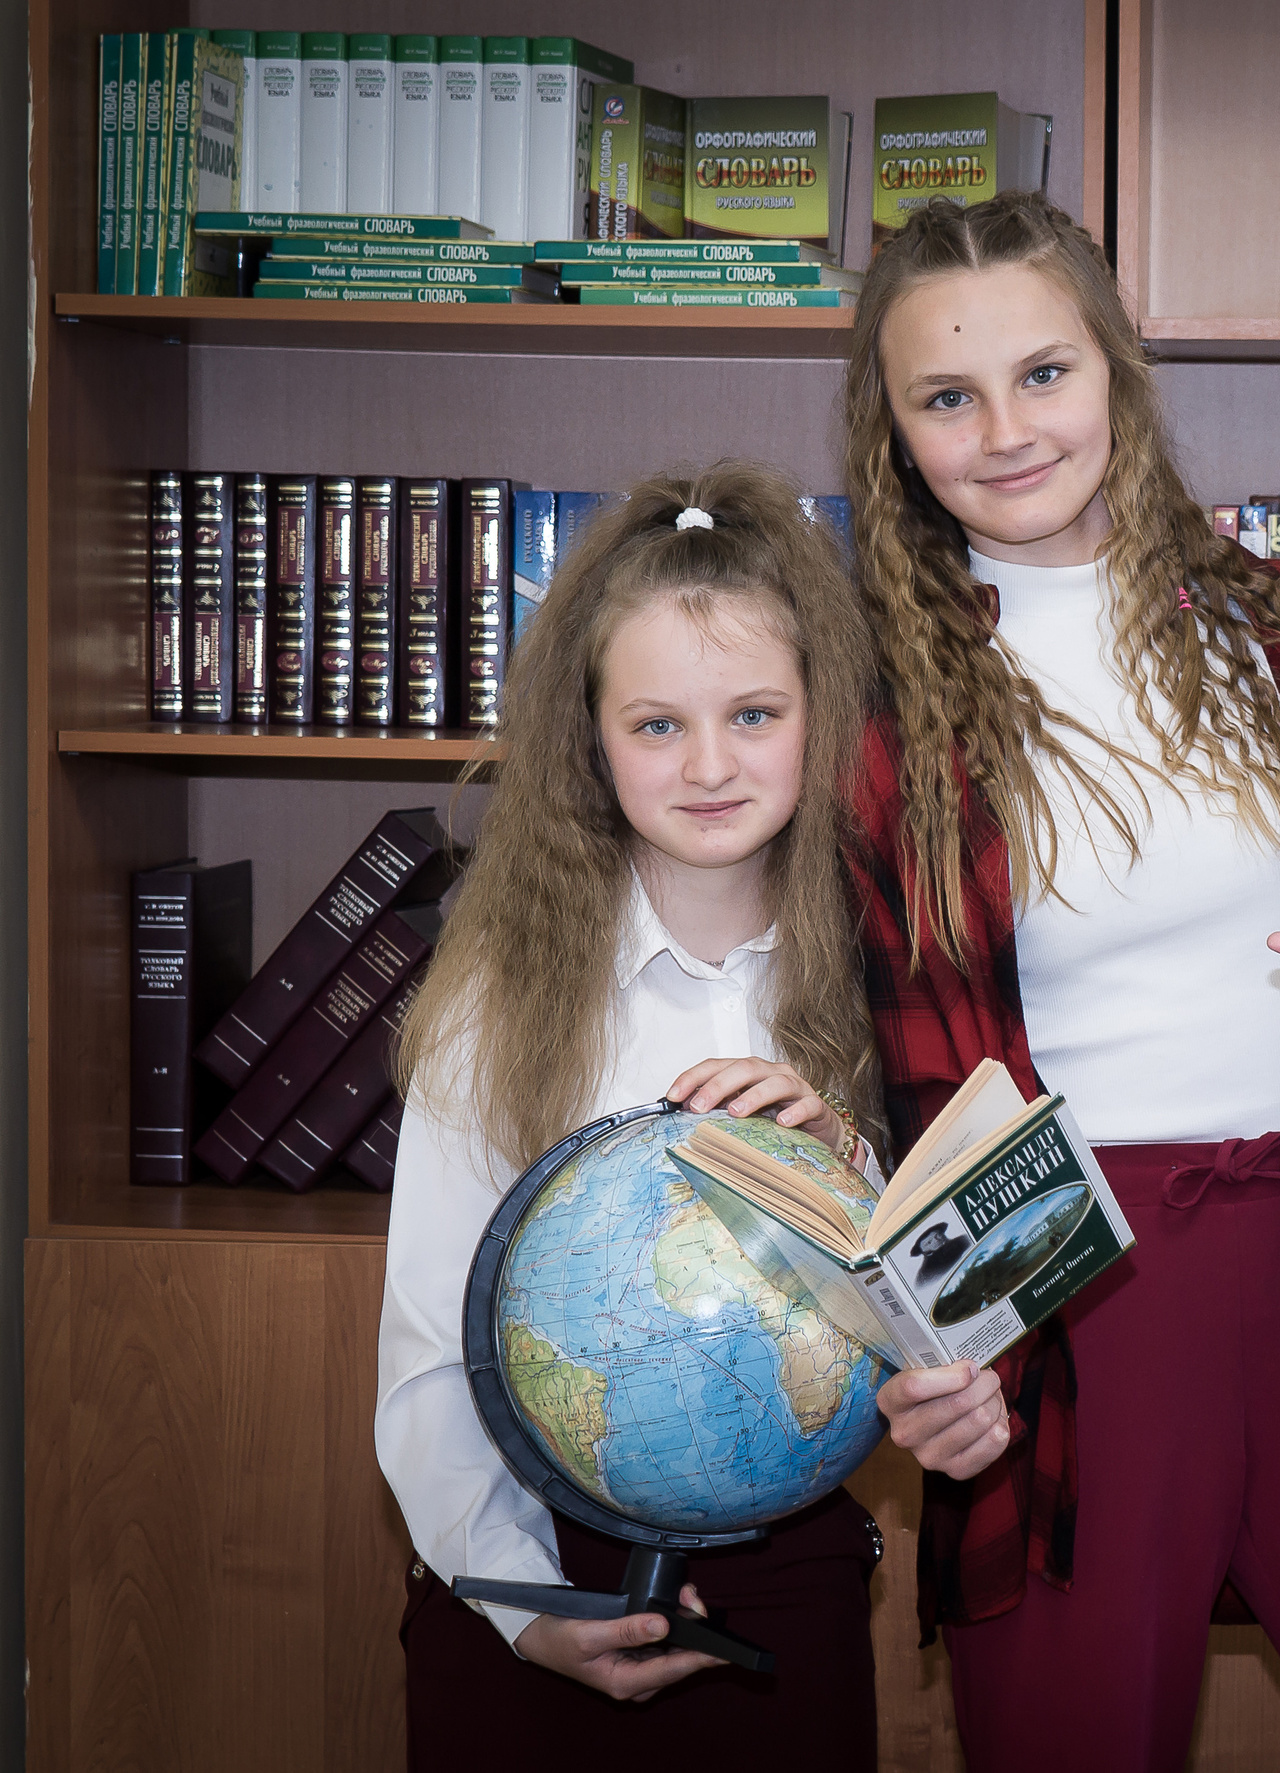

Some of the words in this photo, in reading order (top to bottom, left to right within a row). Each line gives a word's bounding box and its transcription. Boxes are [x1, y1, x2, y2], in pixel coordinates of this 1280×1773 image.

[103, 80, 118, 132] СЛОВАРЬ
[122, 79, 137, 131] СЛОВАРЬ
[146, 79, 162, 131] СЛОВАРЬ
[174, 79, 191, 132] СЛОВАРЬ
[600, 129, 613, 178] СЛОВАРЬ
[695, 128, 817, 150] ОРФОГРАФИЧЕСКИЙ
[880, 129, 988, 151] ОРФОГРАФИЧЕСКИЙ
[103, 137, 116, 210] фразеологический
[121, 136, 134, 210] фразеологический
[144, 136, 158, 210] фразеологический
[171, 136, 186, 210] фразеологический
[695, 156, 816, 188] СЛОВАРЬ
[880, 156, 987, 189] СЛОВАРЬ
[716, 196, 763, 209] РУССКОГО
[763, 196, 796, 209] ЯЗЫКА
[102, 214, 114, 250] Учебный
[120, 214, 131, 249] Учебный
[142, 214, 155, 250] Учебный
[168, 214, 181, 250] Учебный
[248, 215, 282, 228] Учебный
[287, 216, 359, 230] фразеологический
[364, 218, 415, 234] СЛОВАРЬ
[324, 241, 358, 254] Учебный
[363, 243, 434, 257] фразеологический
[439, 244, 490, 261] СЛОВАРЬ
[587, 244, 622, 257] Учебный
[626, 245, 698, 259] фразеологический
[702, 245, 754, 261] СЛОВАРЬ
[312, 264, 346, 277] Учебный
[351, 266, 422, 280] фразеологический
[426, 267, 477, 283] СЛОВАРЬ
[612, 267, 646, 278] Учебный
[650, 267, 721, 282] фразеологический
[726, 267, 776, 282] СЛОВАРЬ
[304, 288, 338, 300] Учебный
[342, 289, 414, 303] фразеологический
[417, 288, 467, 304] СЛОВАРЬ
[633, 292, 667, 304] Учебный
[672, 292, 743, 307] фразеологический
[747, 292, 797, 307] СЛОВАРЬ
[523, 508, 533, 563] РУССКОГО
[329, 896, 363, 926] РУССКОГО
[337, 892, 365, 917] СЛОВАРЬ
[339, 883, 374, 915] ТОЛКОВЫЙ
[329, 908, 352, 929] ЯЗЫКА
[140, 957, 184, 965] ТОЛКОВЫЙ
[144, 965, 179, 973] СЛОВАРЬ
[141, 973, 182, 981] РУССКОГО
[328, 992, 359, 1021] РУССКОГО
[335, 988, 361, 1014] СЛОВАРЬ
[336, 978, 370, 1011] ТОЛКОВЫЙ
[327, 1003, 348, 1024] ЯЗЫКА
[965, 1126, 1055, 1212] АЛЕКСАНДР
[970, 1144, 1067, 1231] ПУШКИН
[1032, 1268, 1066, 1298] Евгений
[1065, 1245, 1095, 1270] Онегин
[728, 1358, 739, 1366] 10°
[735, 1393, 746, 1401] 20°
